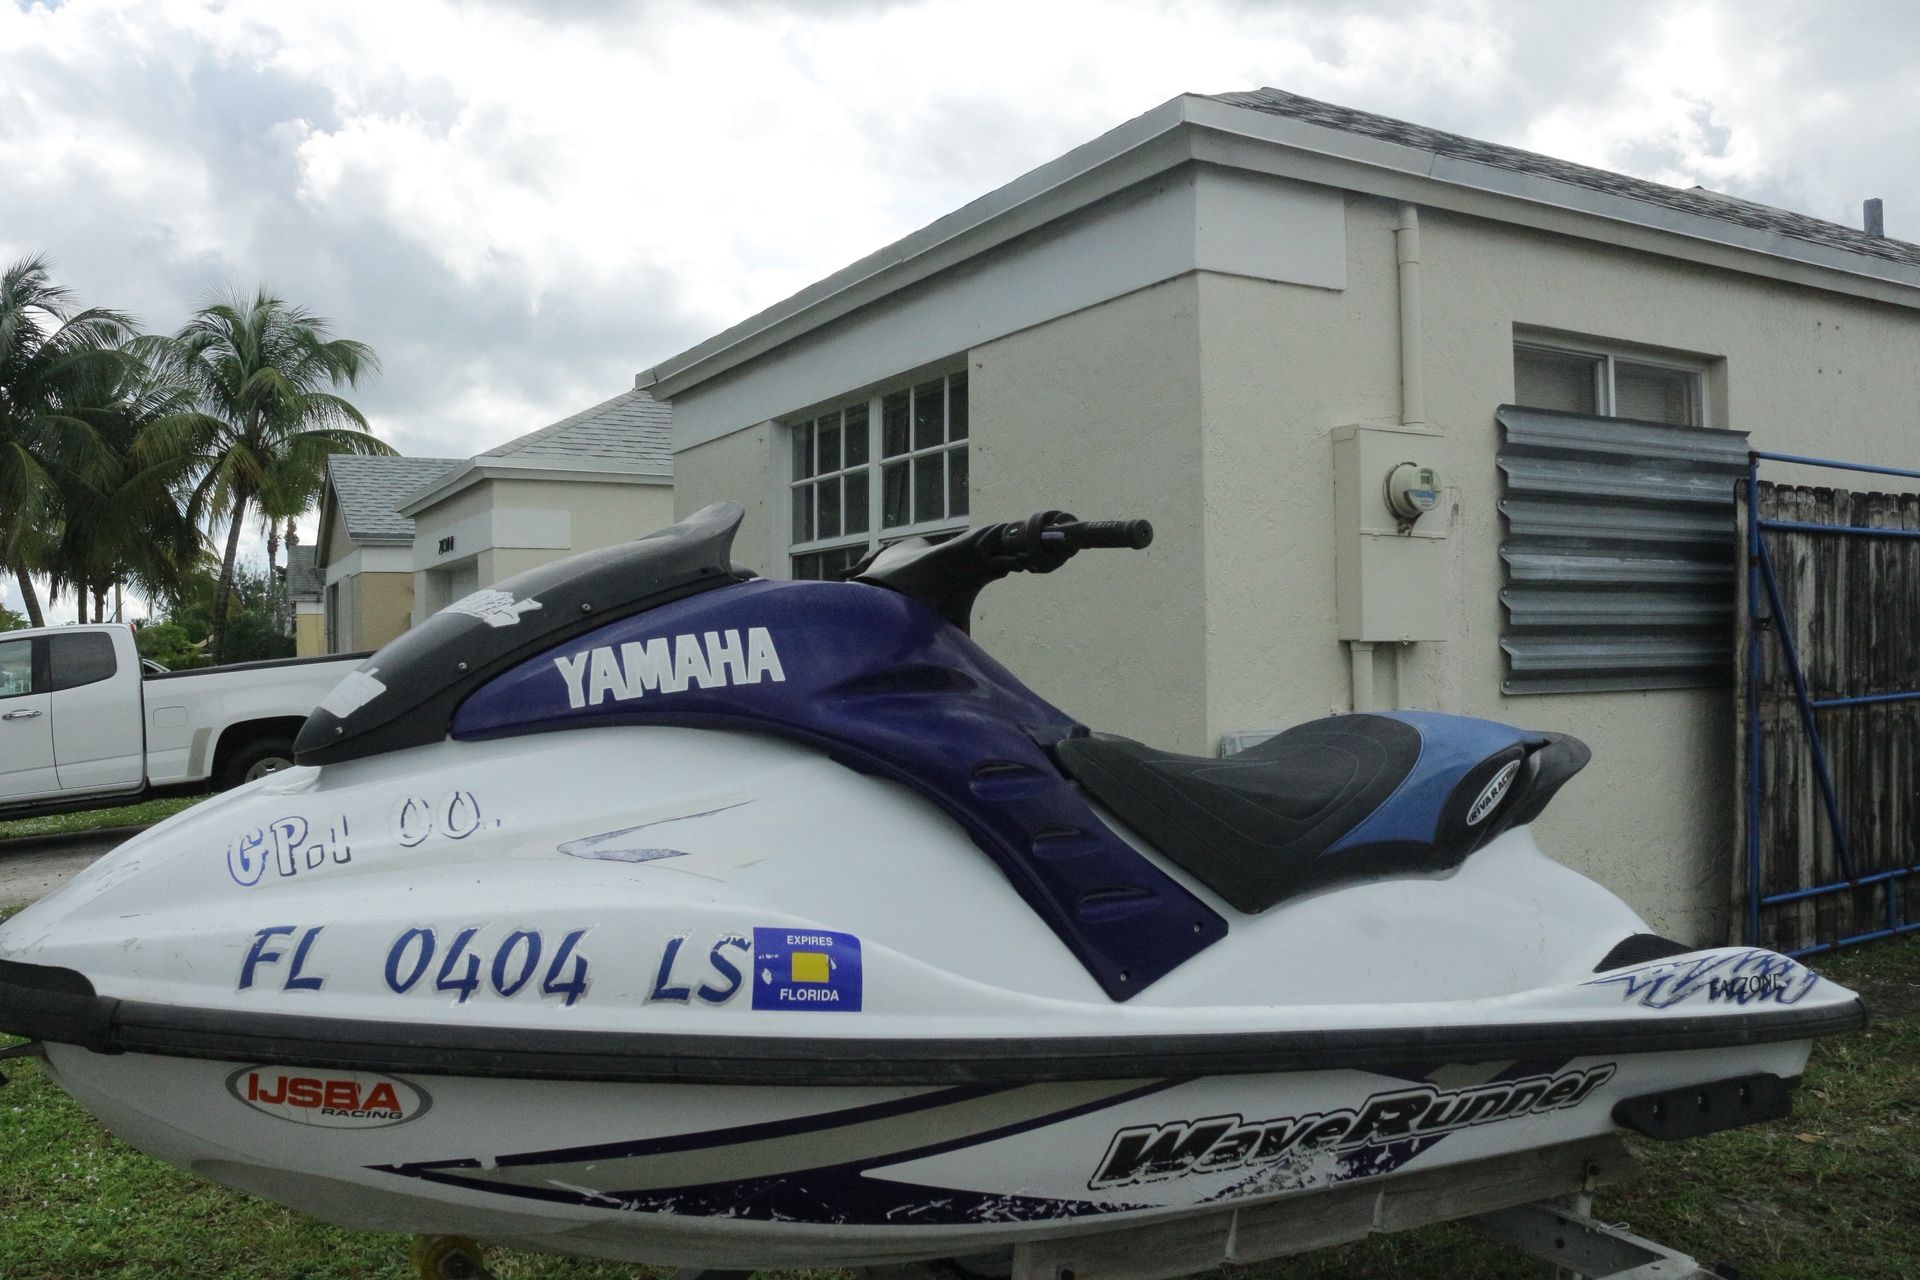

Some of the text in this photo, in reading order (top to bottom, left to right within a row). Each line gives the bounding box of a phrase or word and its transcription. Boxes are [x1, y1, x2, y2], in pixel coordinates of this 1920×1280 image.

[553, 626, 786, 709] YAMAHA
[1470, 795, 1492, 821] RIVA
[786, 935, 833, 947] EXPIRES
[238, 925, 753, 1007] FL 0404 LS
[780, 988, 840, 1002] FLORIDA
[247, 1072, 402, 1112] IJSBA
[320, 1107, 404, 1120] RACING
[1088, 1062, 1618, 1190] WaveRunner
